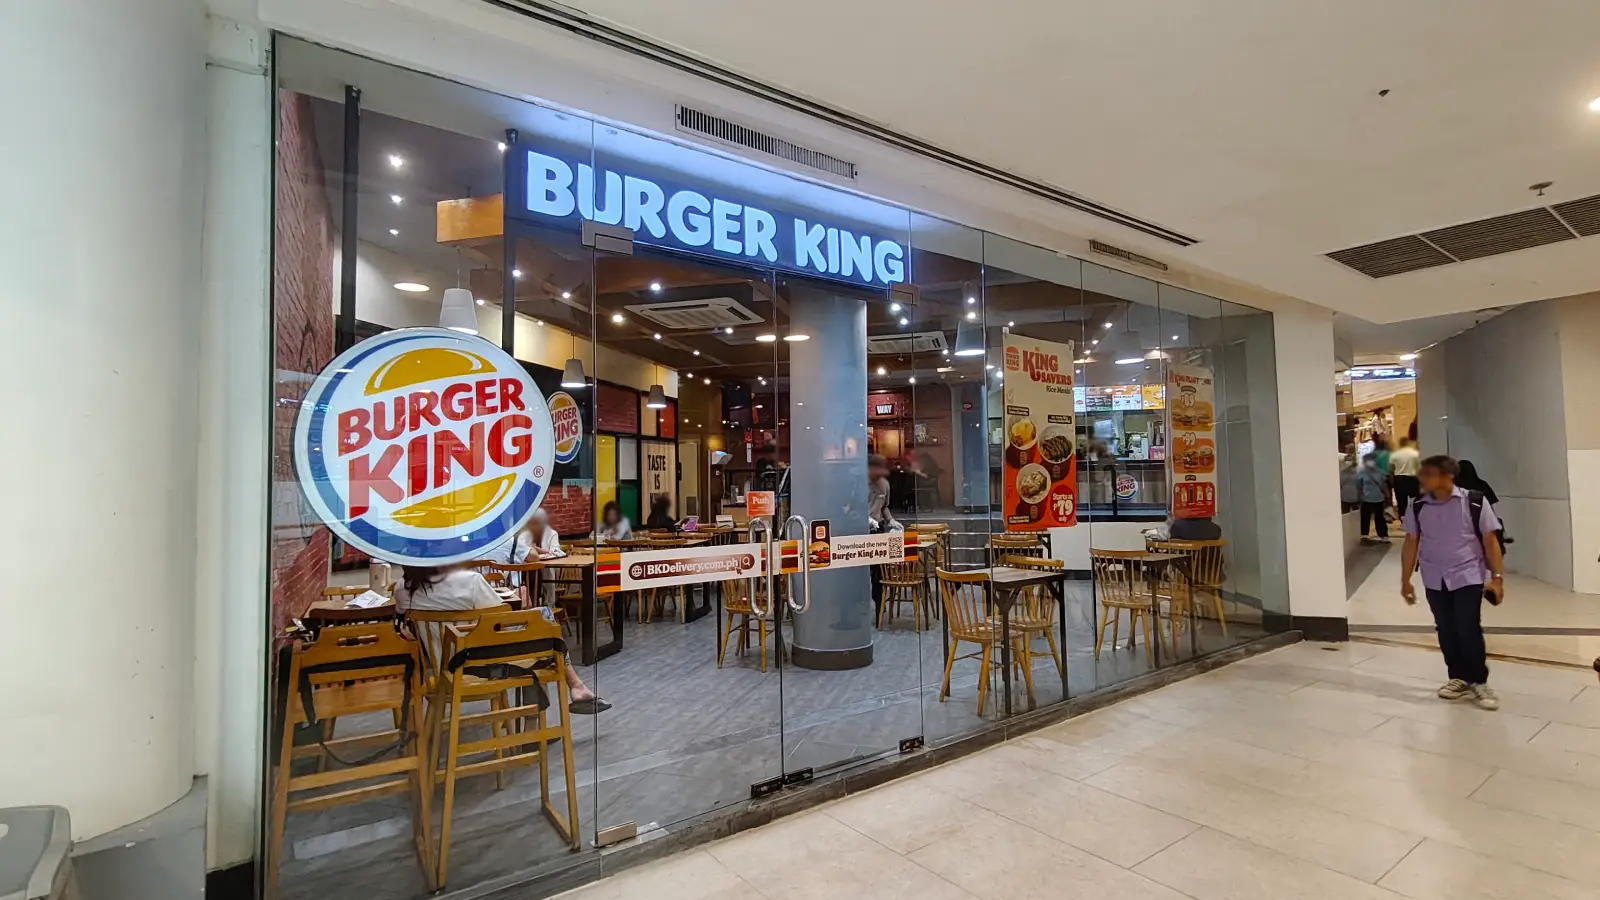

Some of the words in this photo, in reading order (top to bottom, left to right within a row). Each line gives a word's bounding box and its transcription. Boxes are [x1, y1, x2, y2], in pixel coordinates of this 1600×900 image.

[526, 150, 778, 263] BURGER
[794, 218, 904, 284] KING
[1022, 350, 1058, 381] KING
[1041, 372, 1072, 385] SAVERS
[337, 378, 526, 457] BURGER
[551, 407, 577, 424] URGER
[876, 405, 893, 415] WAY
[555, 419, 579, 442] ING
[348, 414, 533, 519] KING
[648, 454, 666, 471] TASTE
[654, 474, 661, 490] IS
[752, 496, 769, 504] Push
[832, 552, 857, 560] Burger
[857, 550, 874, 558] King
[874, 549, 887, 557] App
[837, 542, 865, 551] Download
[647, 558, 739, 575] BKDelivery.com.ph
